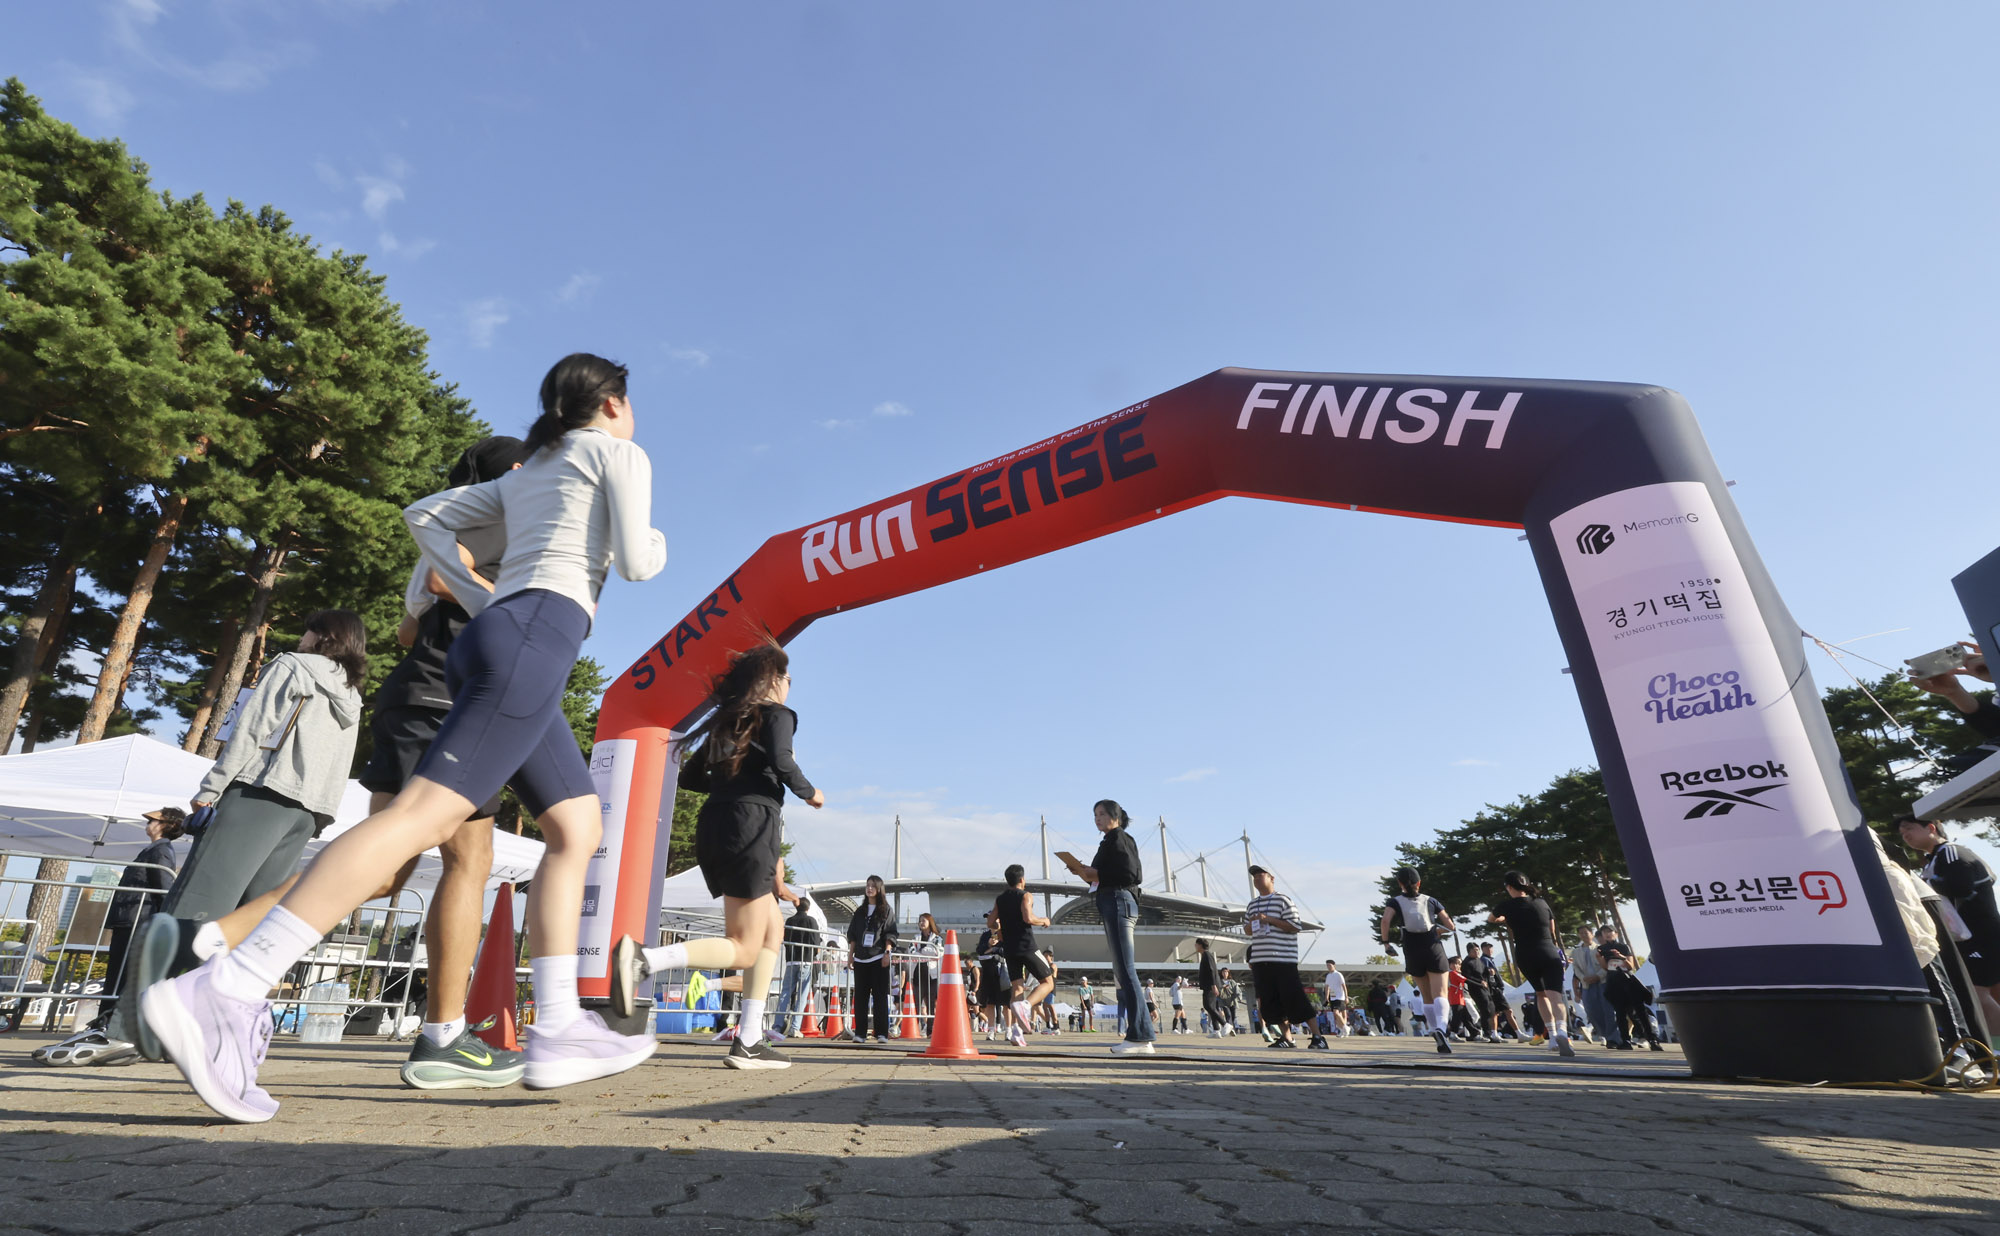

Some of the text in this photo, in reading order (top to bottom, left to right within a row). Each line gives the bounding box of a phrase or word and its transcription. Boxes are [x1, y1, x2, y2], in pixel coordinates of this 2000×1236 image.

[1236, 382, 1524, 450] FINISH
[972, 400, 1151, 473] RUN The Record, Feel The SENSE
[1623, 512, 1699, 534] MemorinG
[631, 570, 744, 690] START
[1614, 613, 1725, 640] KYUNGGI TTEOK HOUSE
[1648, 670, 1740, 699] Choco
[1644, 683, 1757, 724] Health
[1660, 760, 1789, 791] Reebok
[1680, 876, 1798, 907] 일요신문
[1699, 904, 1785, 916] REALTIME NEWS MEDIA
